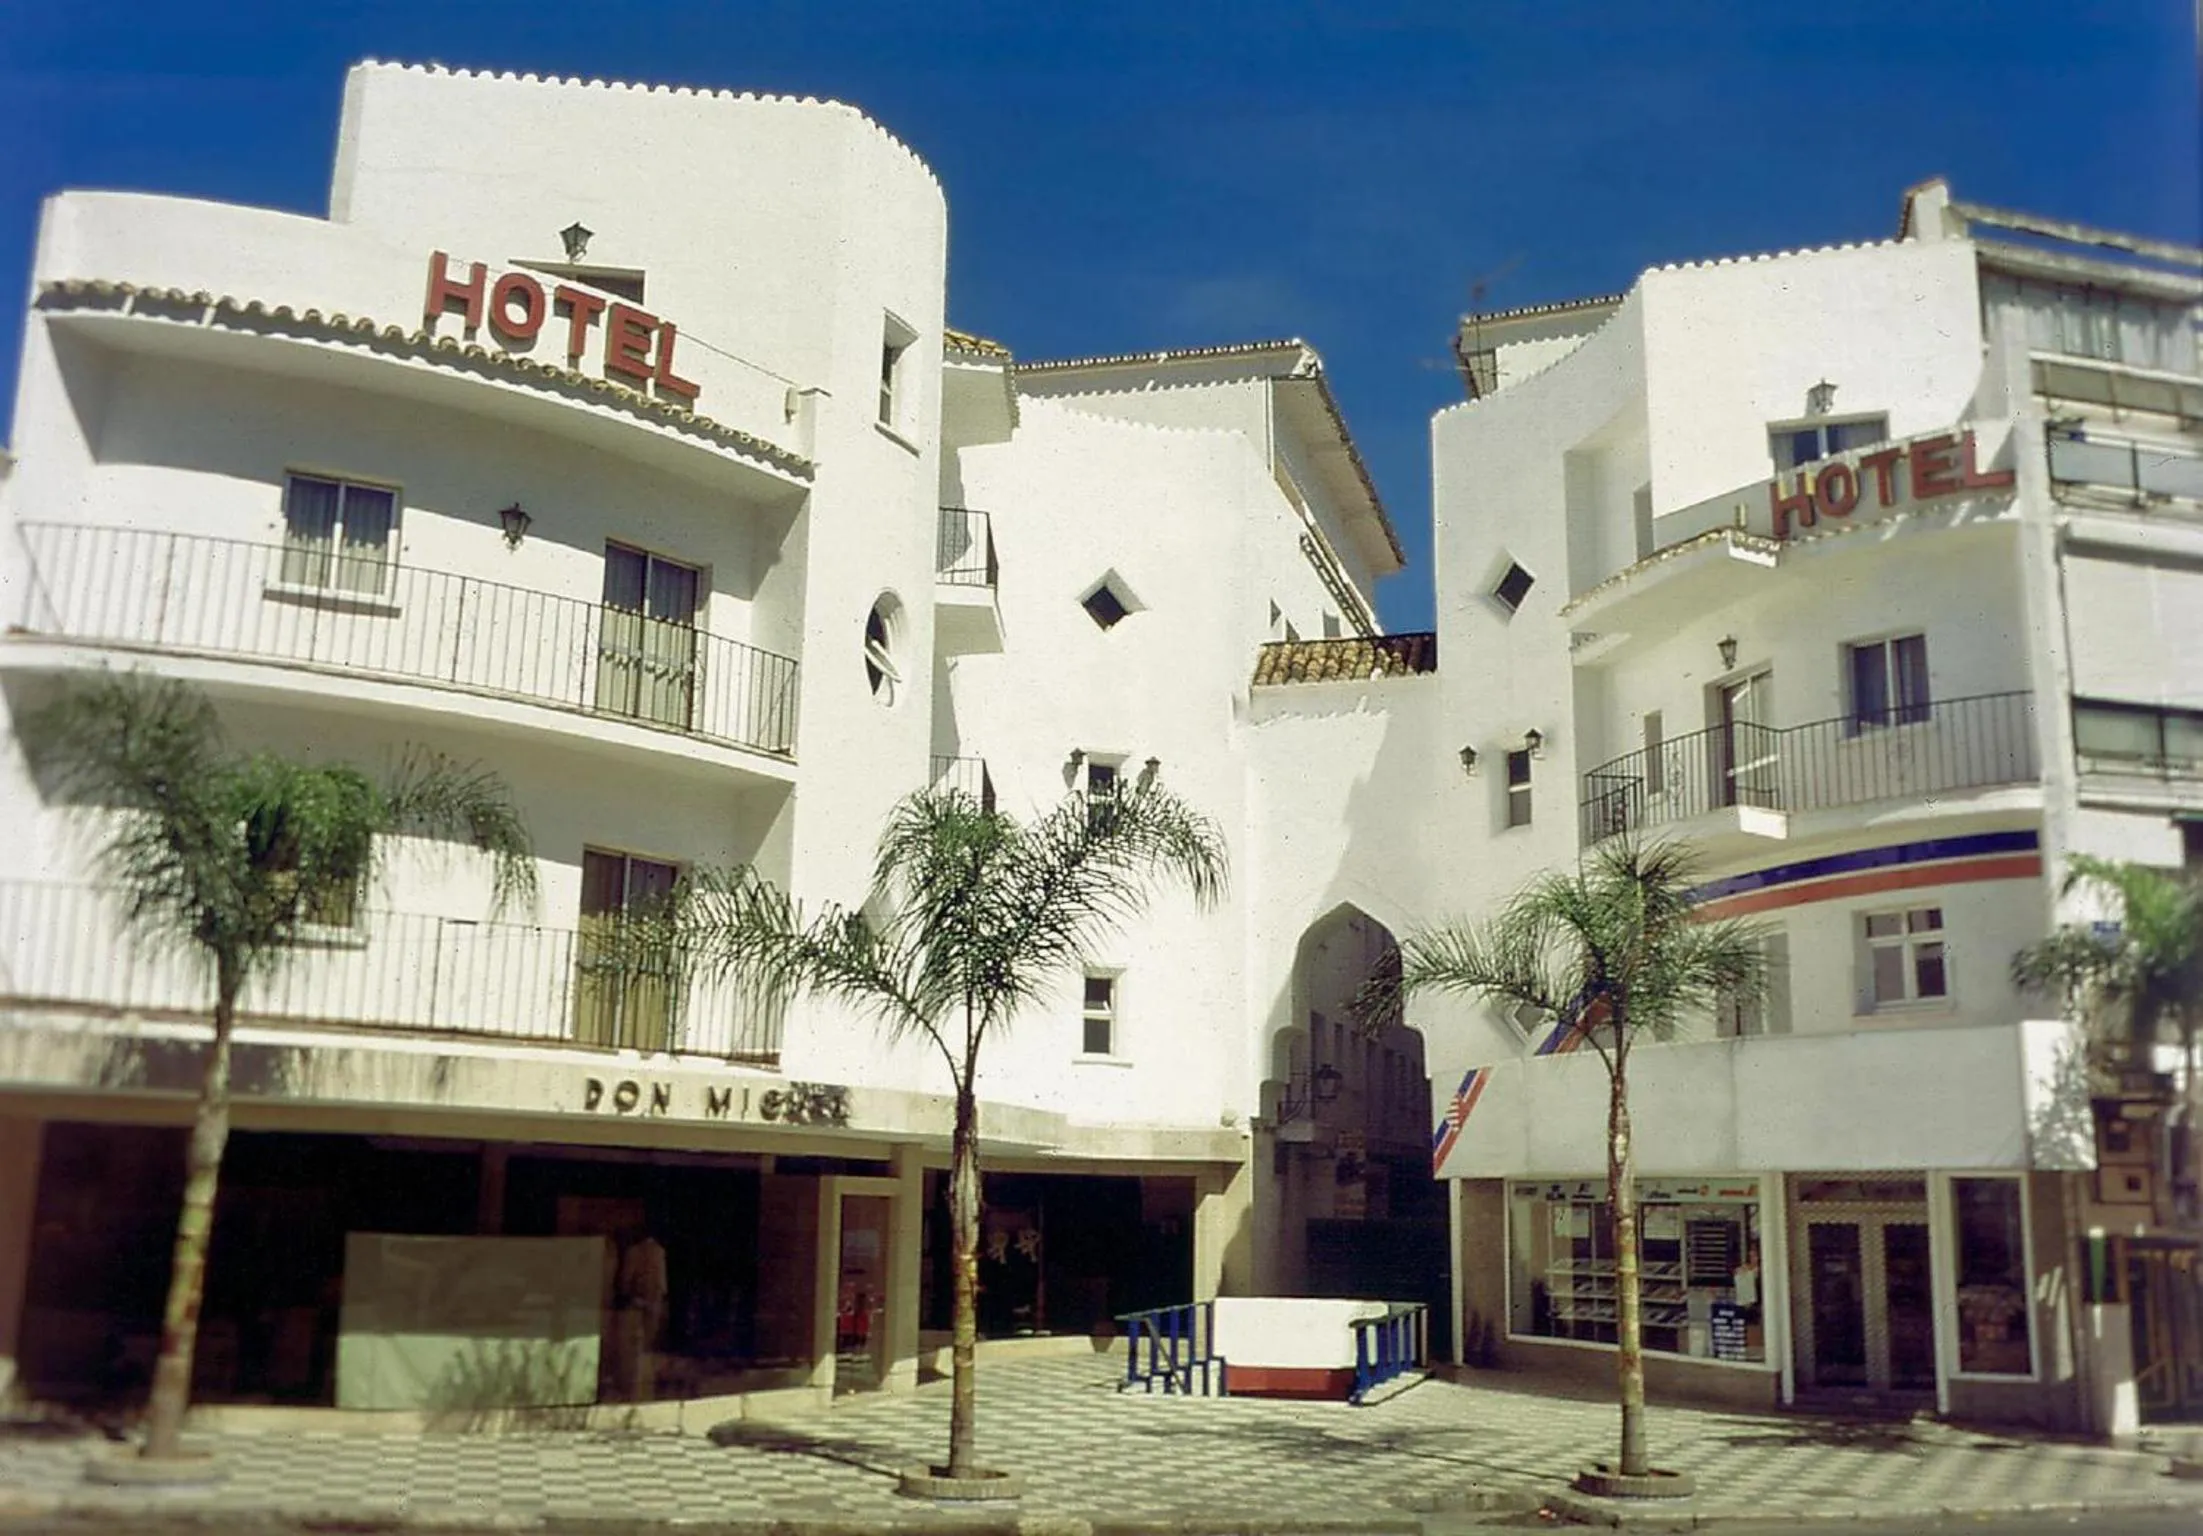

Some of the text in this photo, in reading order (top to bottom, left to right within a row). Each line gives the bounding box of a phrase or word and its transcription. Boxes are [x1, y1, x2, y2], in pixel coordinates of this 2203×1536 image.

[424, 250, 701, 402] HOTEL
[1769, 429, 2015, 541] HOTEL
[584, 1078, 671, 1114] DON
